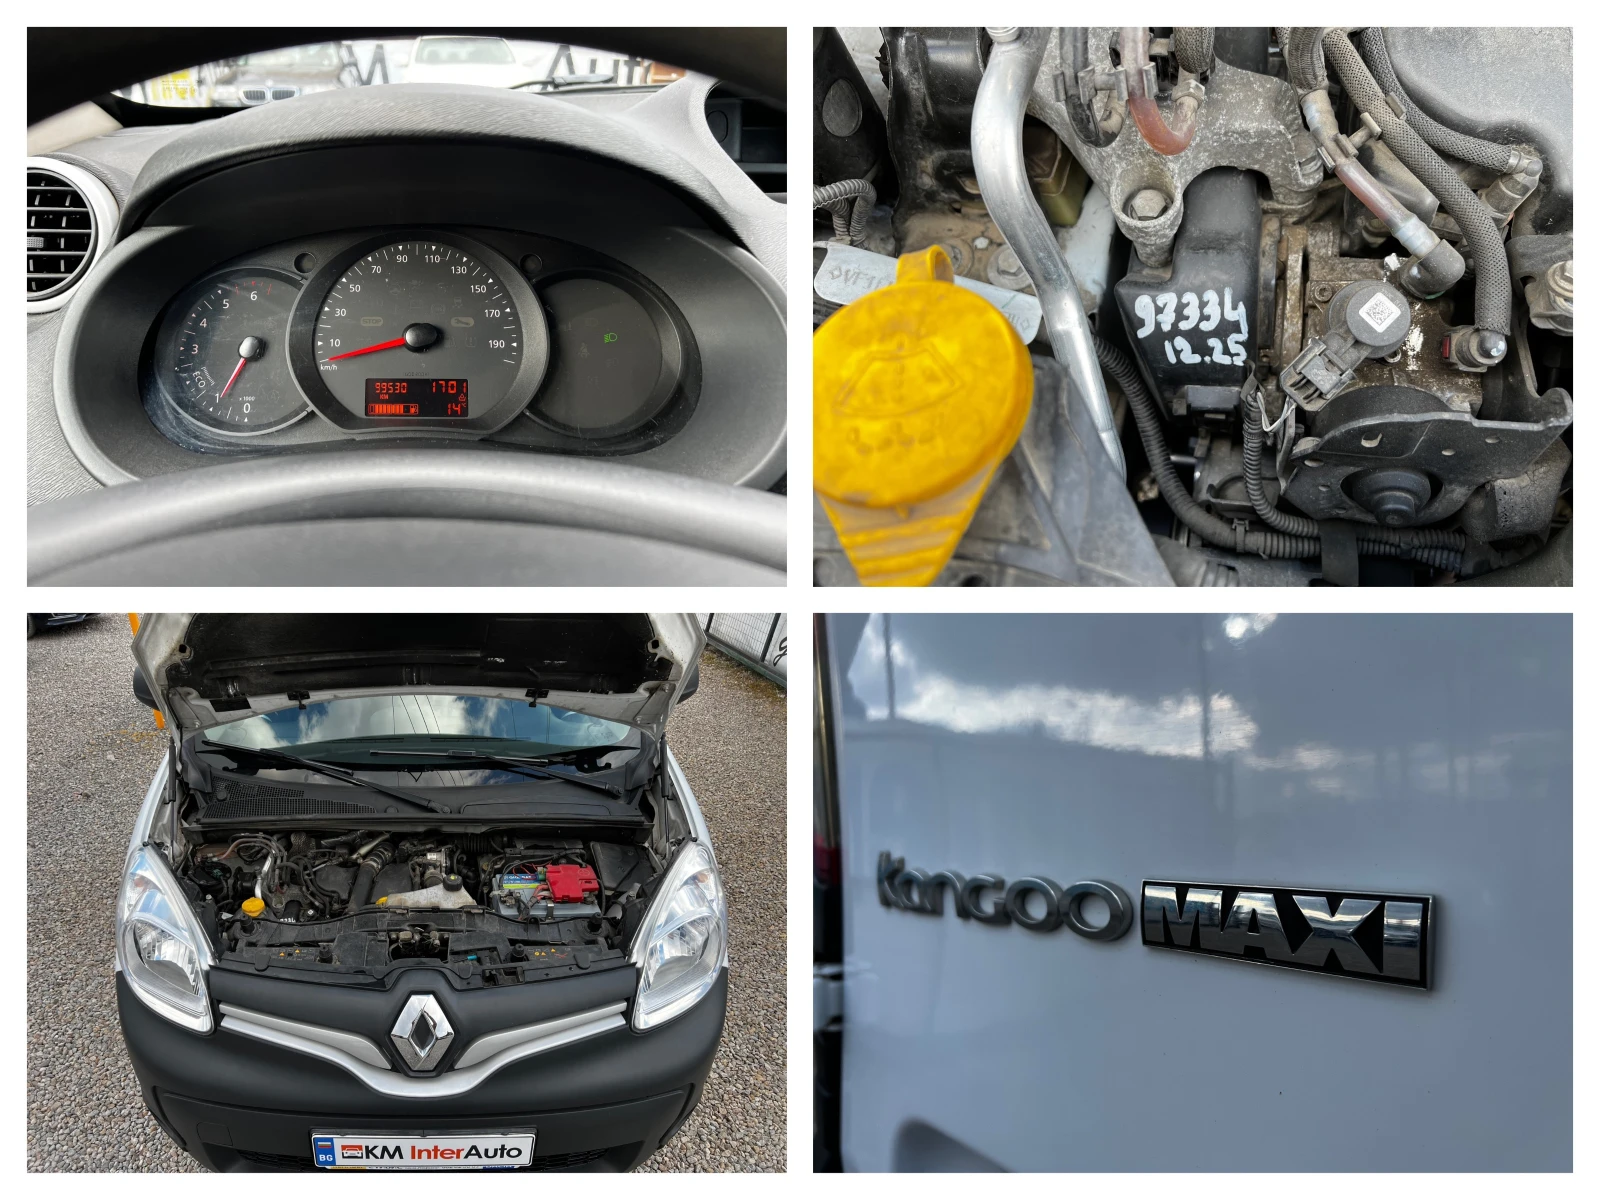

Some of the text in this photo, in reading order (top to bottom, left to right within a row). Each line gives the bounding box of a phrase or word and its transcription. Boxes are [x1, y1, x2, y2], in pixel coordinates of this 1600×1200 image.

[396, 254, 408, 263] 90
[425, 254, 441, 263] 110
[371, 265, 382, 274] 70
[451, 265, 467, 275] 130
[349, 284, 361, 293] 50
[470, 284, 487, 293] 150
[250, 290, 258, 301] 6
[222, 298, 230, 309] 5
[335, 308, 347, 317] 30
[484, 309, 501, 318] 170
[1135, 287, 1248, 339] 97334
[199, 317, 207, 328] 4
[329, 338, 341, 347] 10
[488, 339, 505, 349] 190
[191, 344, 199, 354] 3
[1164, 333, 1248, 366] 12.25
[320, 363, 338, 372] km/h
[192, 370, 206, 388] ECO
[375, 382, 408, 393] 99530
[215, 393, 220, 403] 1
[243, 402, 251, 414] 0
[1143, 884, 1425, 981] MAXI
[365, 1144, 523, 1160] KM InterAuto
[319, 1154, 333, 1162] BG
